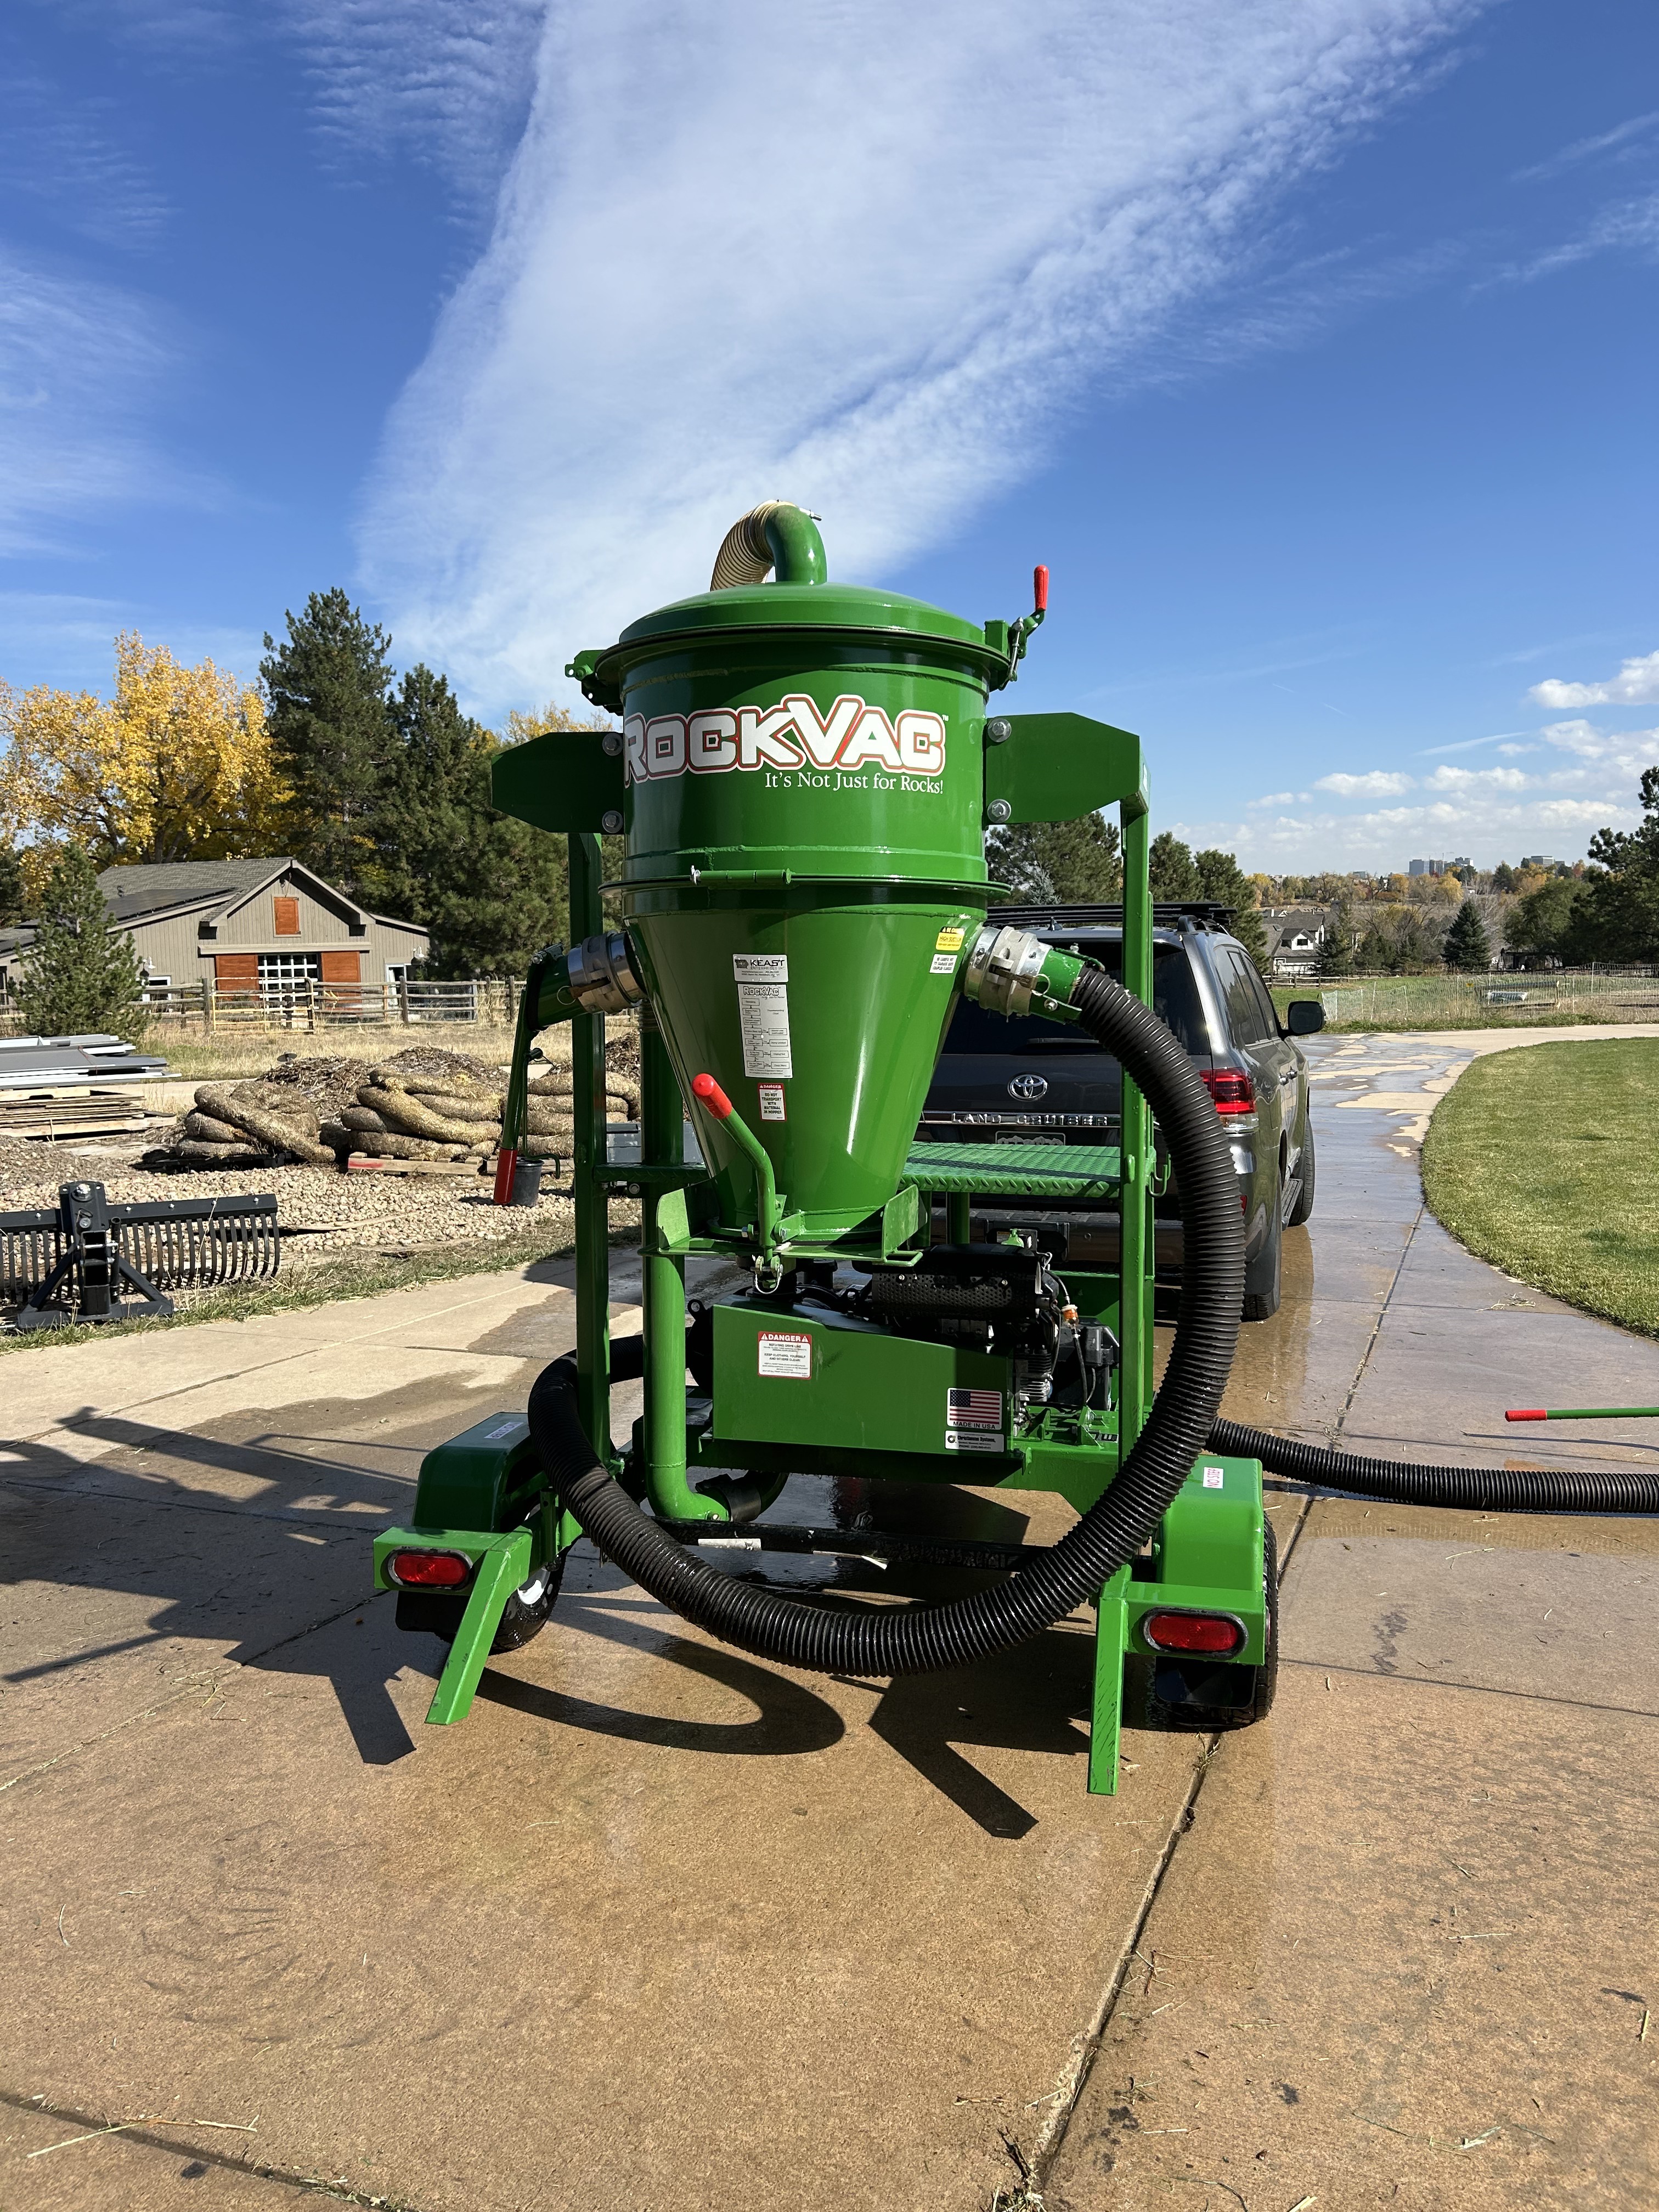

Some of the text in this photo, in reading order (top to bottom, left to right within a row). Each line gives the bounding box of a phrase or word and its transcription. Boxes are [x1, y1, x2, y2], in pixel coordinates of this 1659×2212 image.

[765, 772, 944, 794] It's Not Just for Rocks!
[951, 1113, 1108, 1126] LAND CRUISER
[768, 1334, 801, 1342] DANGER
